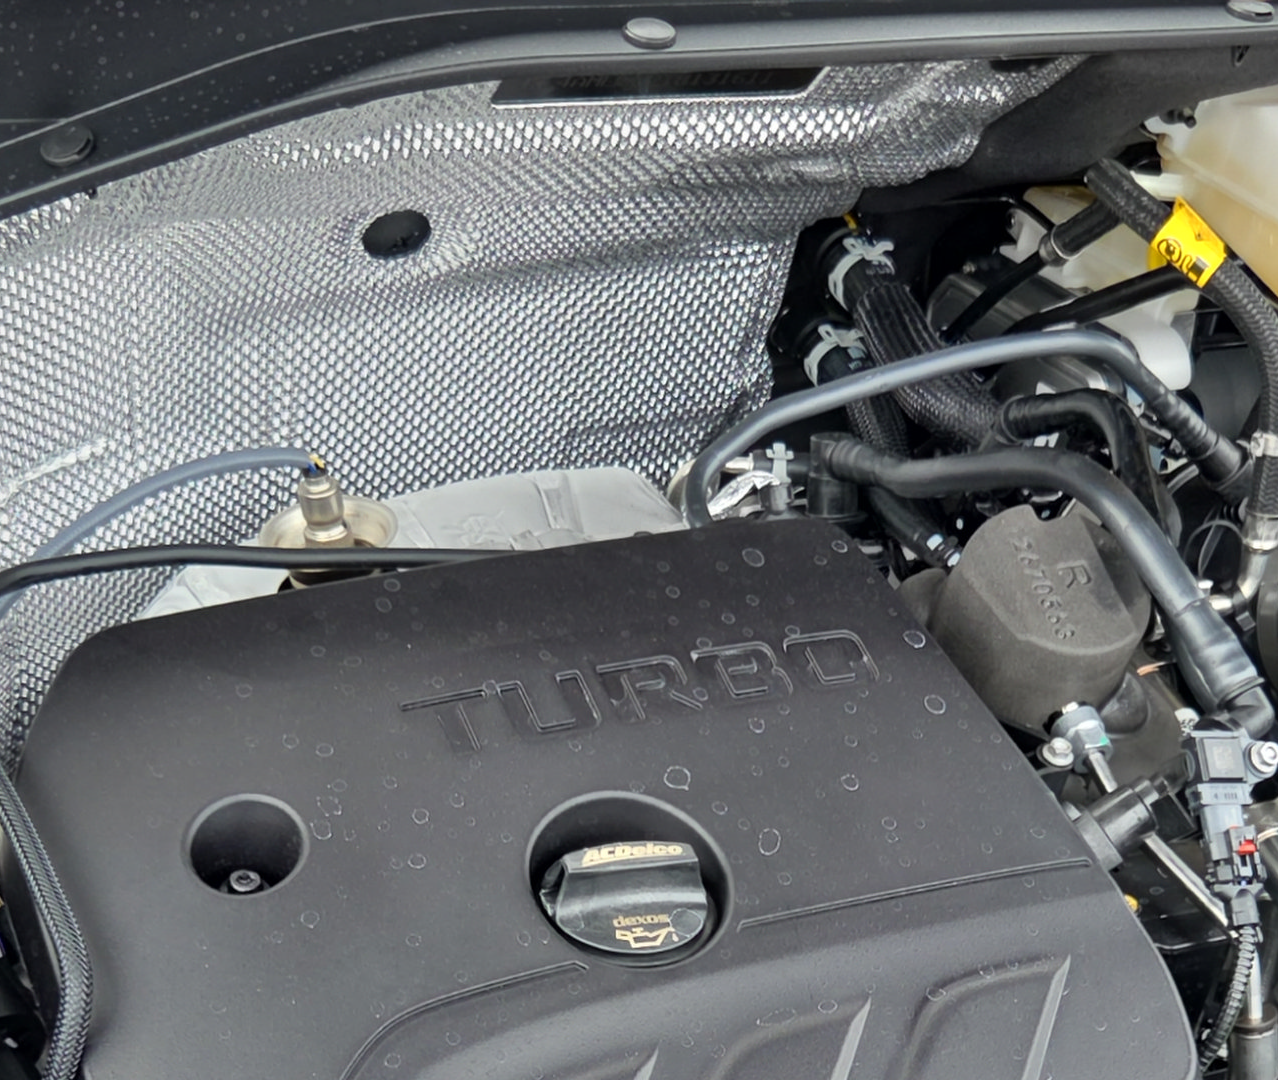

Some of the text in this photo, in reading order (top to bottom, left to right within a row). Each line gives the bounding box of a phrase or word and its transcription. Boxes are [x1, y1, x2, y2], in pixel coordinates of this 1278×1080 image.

[1058, 559, 1092, 589] R
[400, 629, 881, 751] TURBO
[581, 842, 684, 867] ACDelco
[612, 913, 670, 928] dexos
